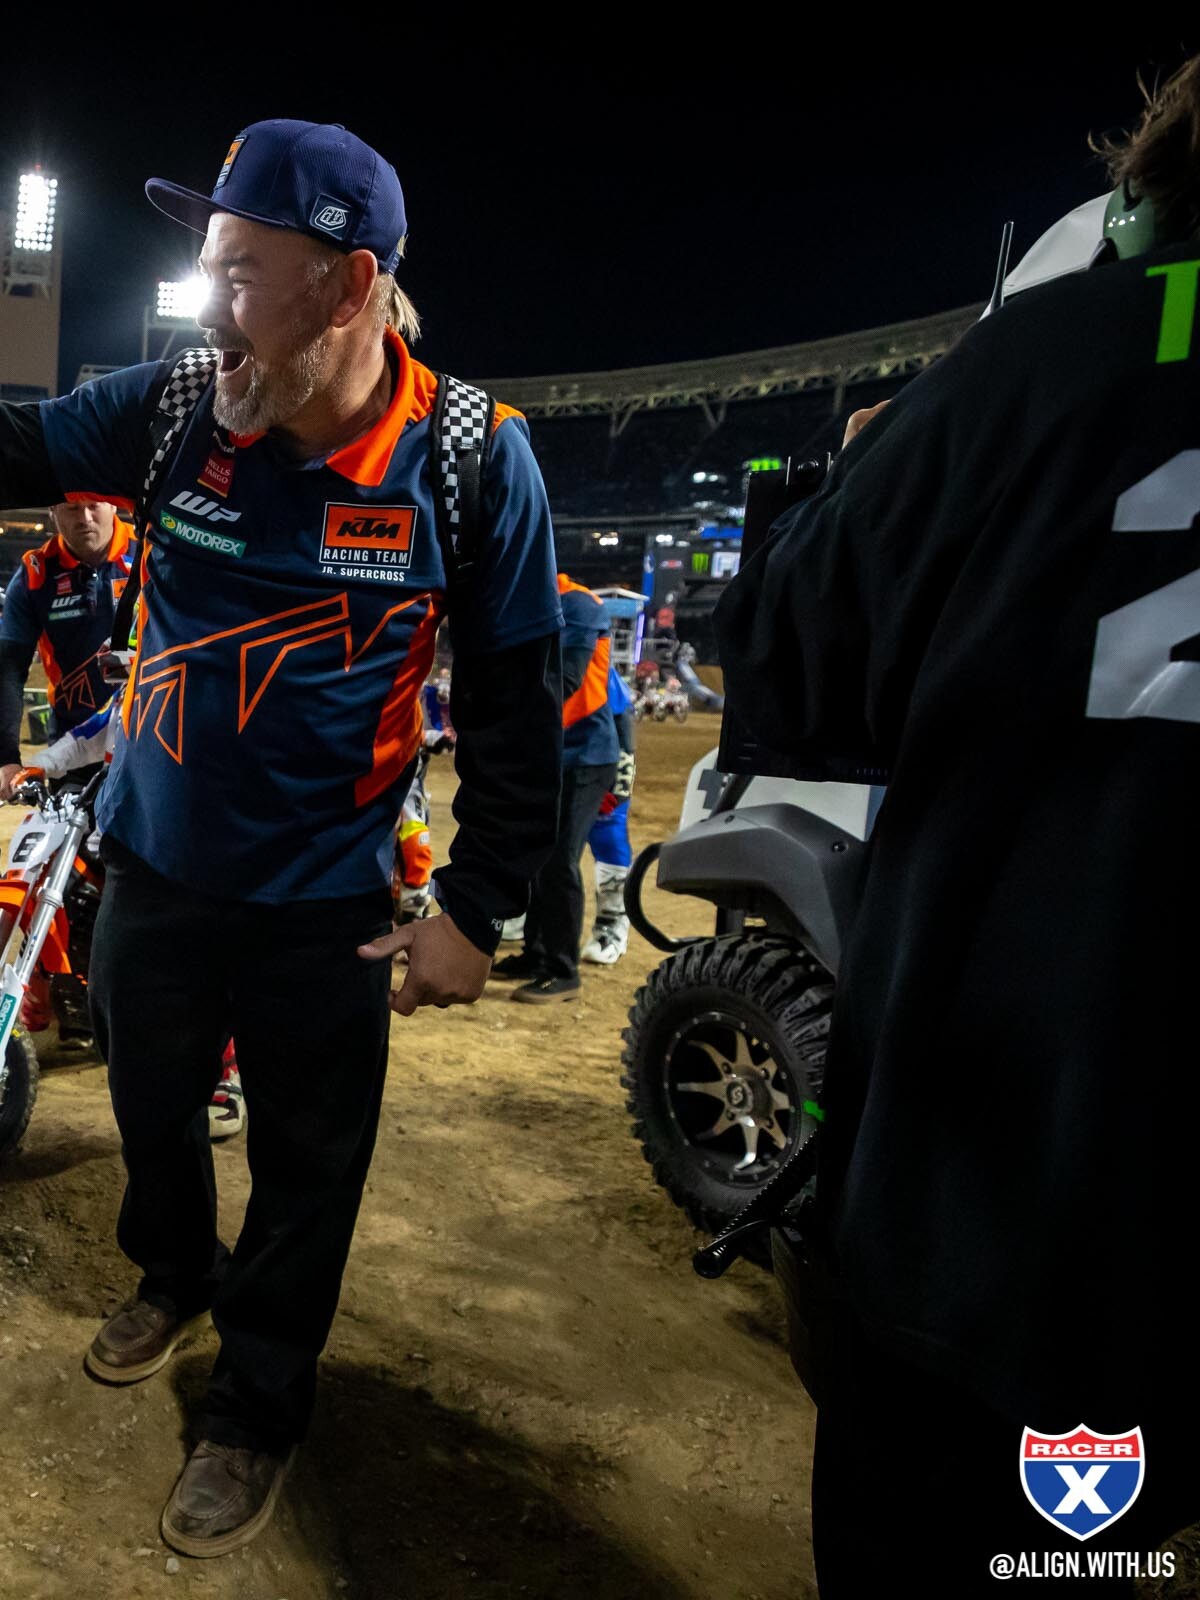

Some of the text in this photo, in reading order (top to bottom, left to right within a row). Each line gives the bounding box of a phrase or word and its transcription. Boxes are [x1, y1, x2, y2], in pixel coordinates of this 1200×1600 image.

[169, 490, 242, 522] WP
[175, 521, 241, 555] MOTOREX
[336, 517, 401, 539] KTM
[323, 548, 408, 564] RACING TEAM
[322, 566, 405, 582] JR. SUPERCROSS
